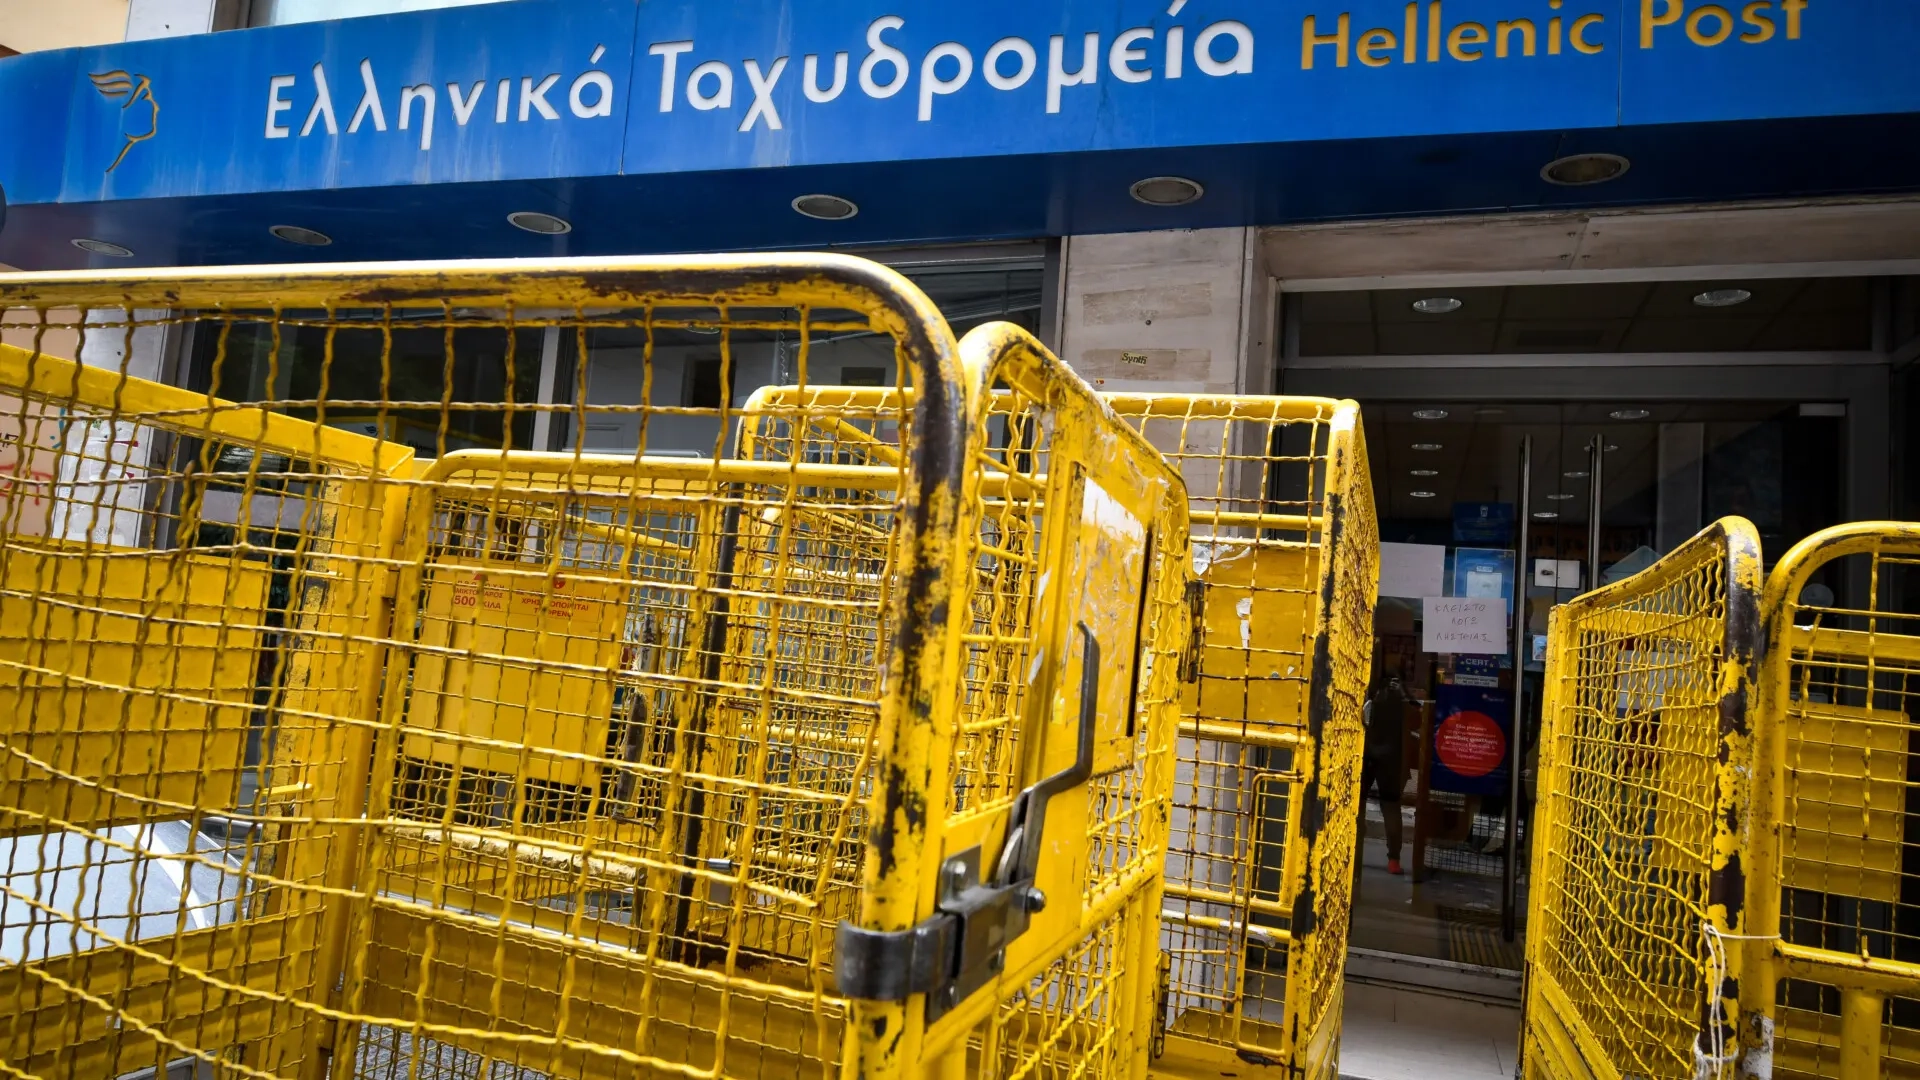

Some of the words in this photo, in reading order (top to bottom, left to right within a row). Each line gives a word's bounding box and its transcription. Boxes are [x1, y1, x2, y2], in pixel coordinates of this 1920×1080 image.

[1301, 0, 1604, 70] Hellenic
[1639, 0, 1808, 49] Post
[264, 45, 613, 151] Ελληνικά
[648, 0, 1254, 132] Ταχυδρομεία
[484, 590, 504, 599] ΑΡΟΣ
[454, 595, 476, 607] 500
[1435, 603, 1487, 613] ΚΛΕΙΣΤΟ
[1465, 658, 1490, 667] CERT
